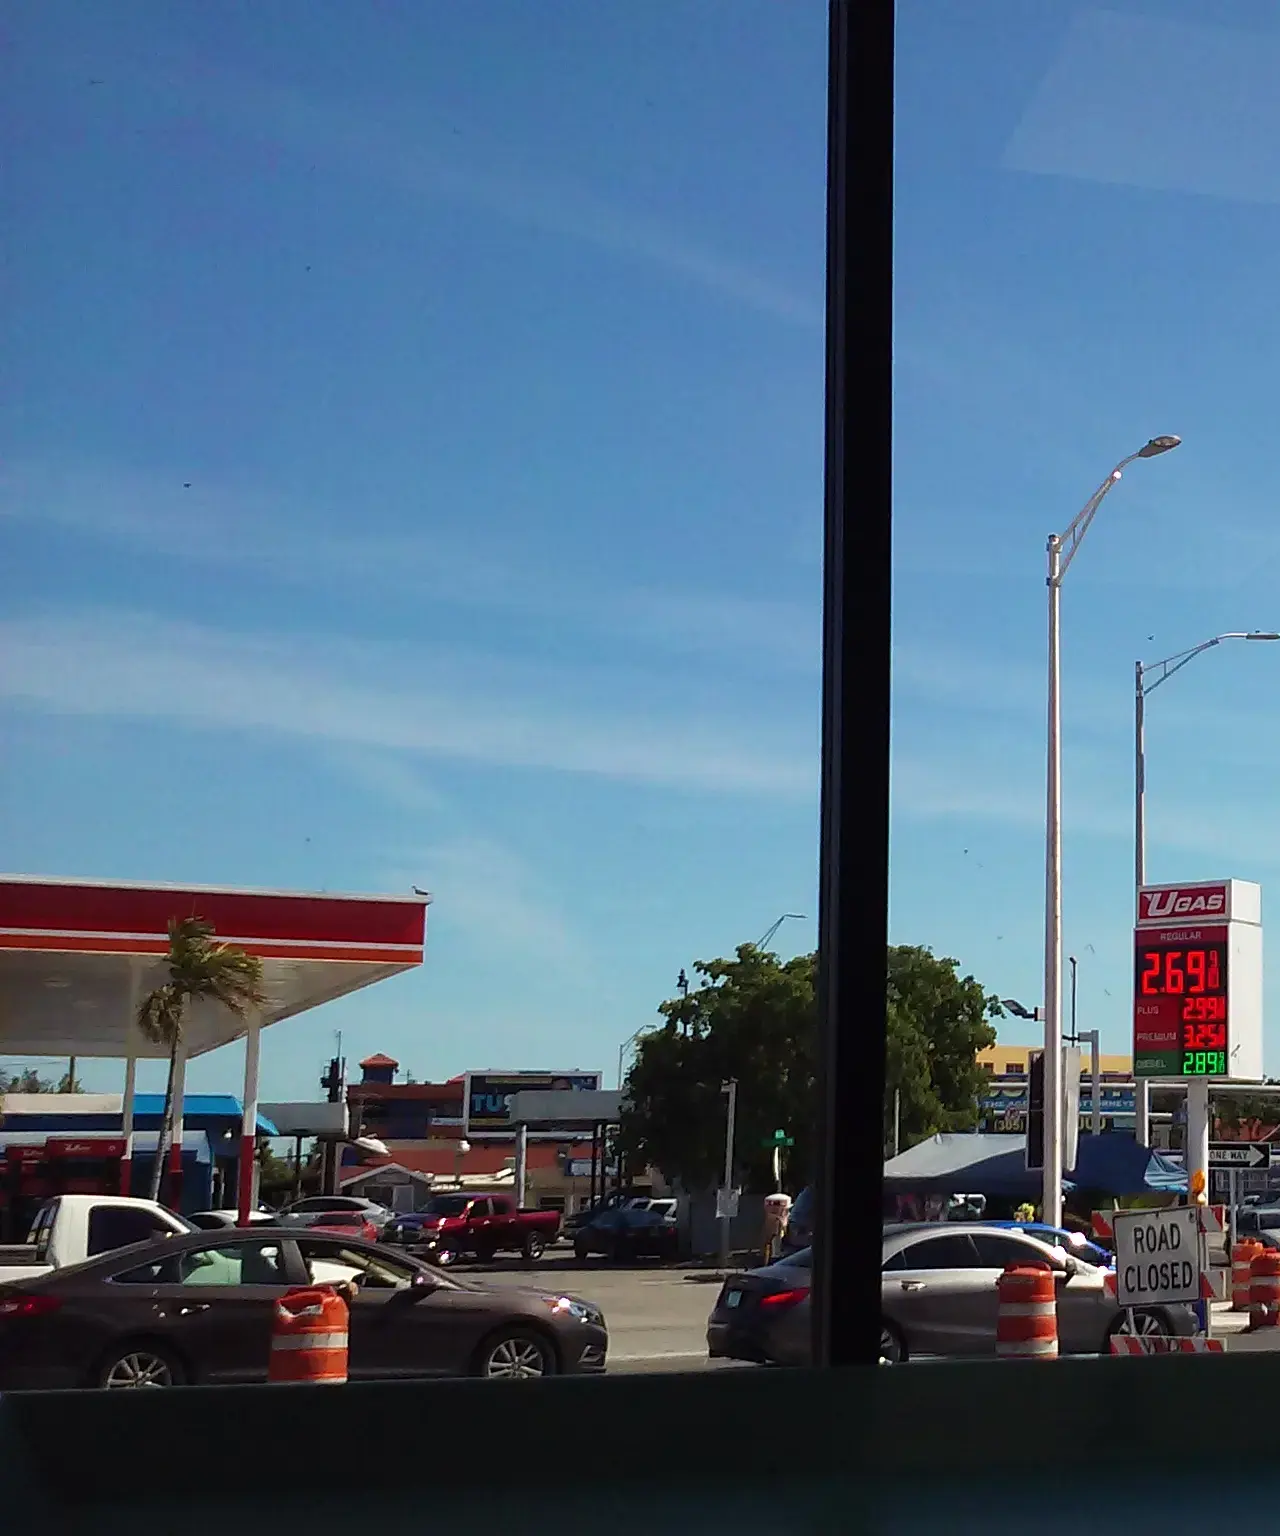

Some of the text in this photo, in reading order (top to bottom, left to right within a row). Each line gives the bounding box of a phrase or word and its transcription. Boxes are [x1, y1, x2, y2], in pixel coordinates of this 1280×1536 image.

[1142, 891, 1224, 917] UGAS
[1160, 931, 1202, 941] REGULAR
[1137, 1006, 1159, 1015] PLUS
[1136, 1032, 1177, 1041] PREMIUM
[1210, 1151, 1248, 1160] ONE WAY
[1134, 1223, 1181, 1254] ROAD
[1125, 1260, 1193, 1293] CLOSED
